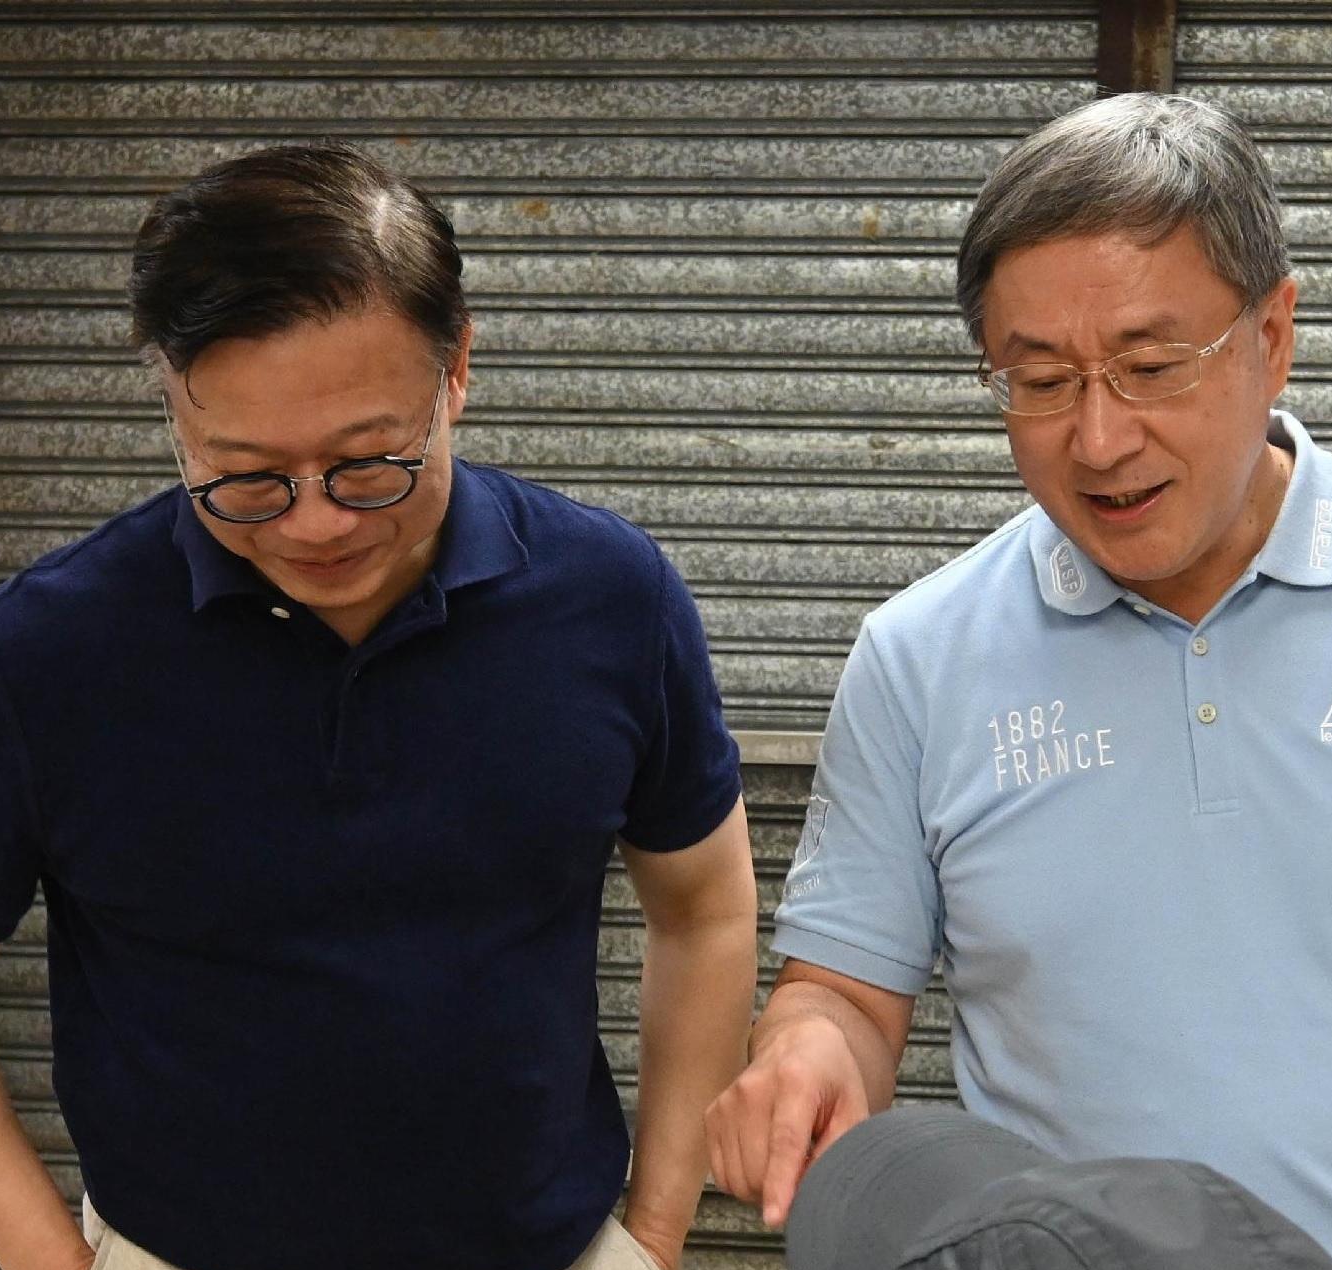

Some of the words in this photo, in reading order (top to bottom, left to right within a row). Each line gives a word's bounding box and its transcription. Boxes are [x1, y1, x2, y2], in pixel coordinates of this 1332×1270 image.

[1058, 547, 1078, 590] WSF
[988, 700, 1066, 752] 1882
[1320, 727, 1332, 743] le
[994, 729, 1116, 792] FRANCE
